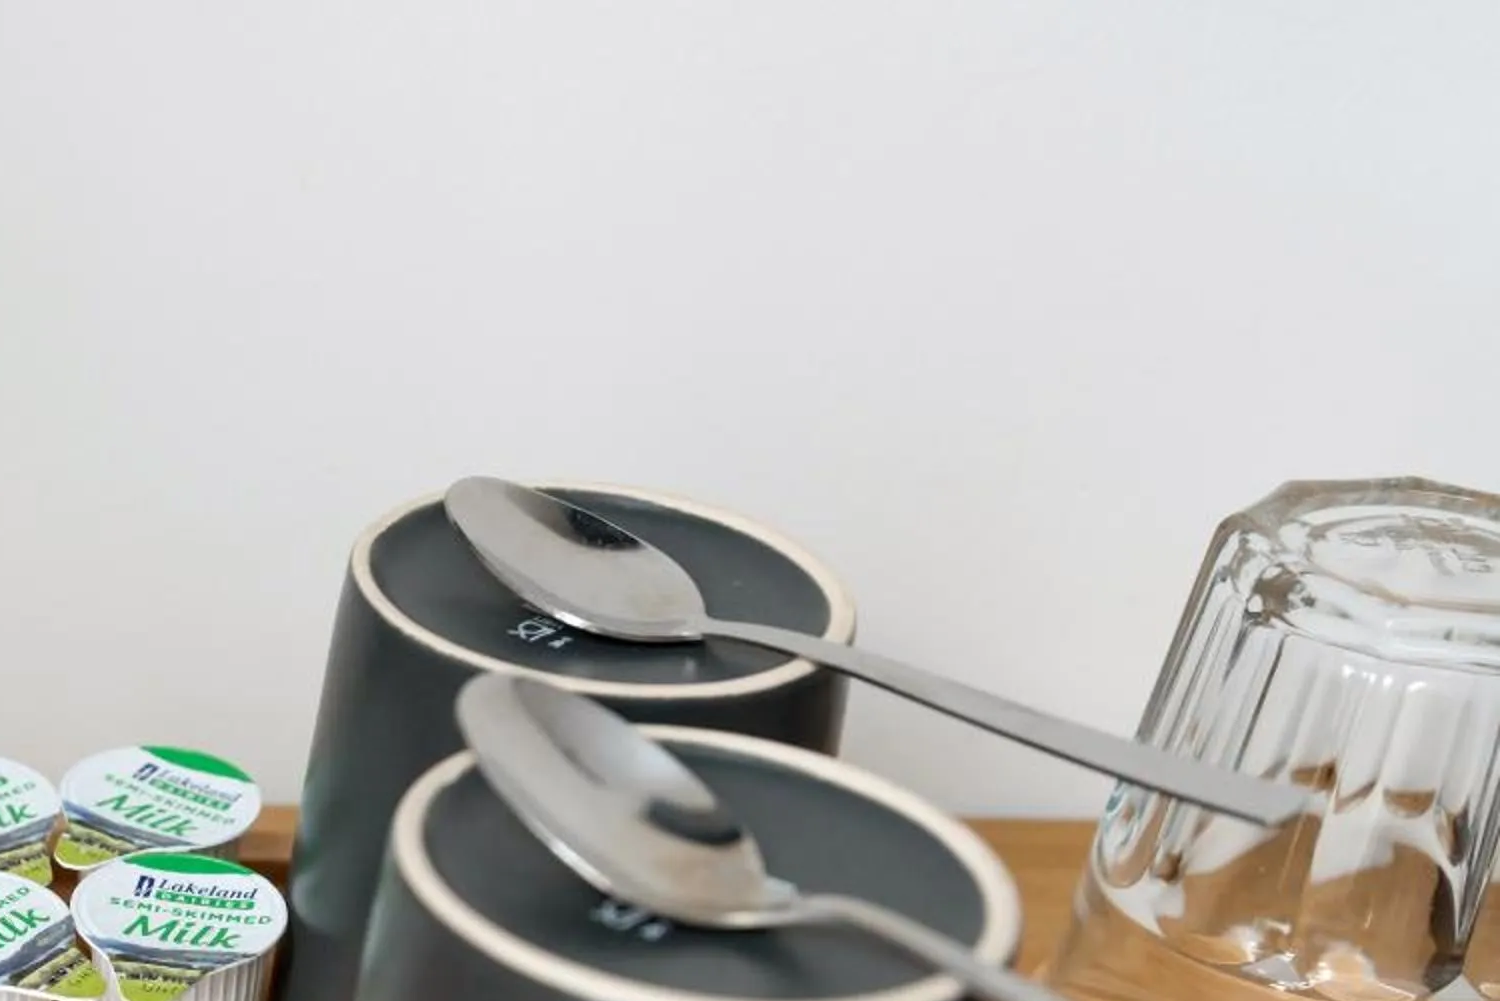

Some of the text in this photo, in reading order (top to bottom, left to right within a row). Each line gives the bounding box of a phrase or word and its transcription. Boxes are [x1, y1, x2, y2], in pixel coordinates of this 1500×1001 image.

[96, 793, 197, 836] Milk
[158, 878, 258, 900] Lakeland
[110, 897, 272, 925] SEMI-SKIMMED
[122, 915, 242, 949] Milk
